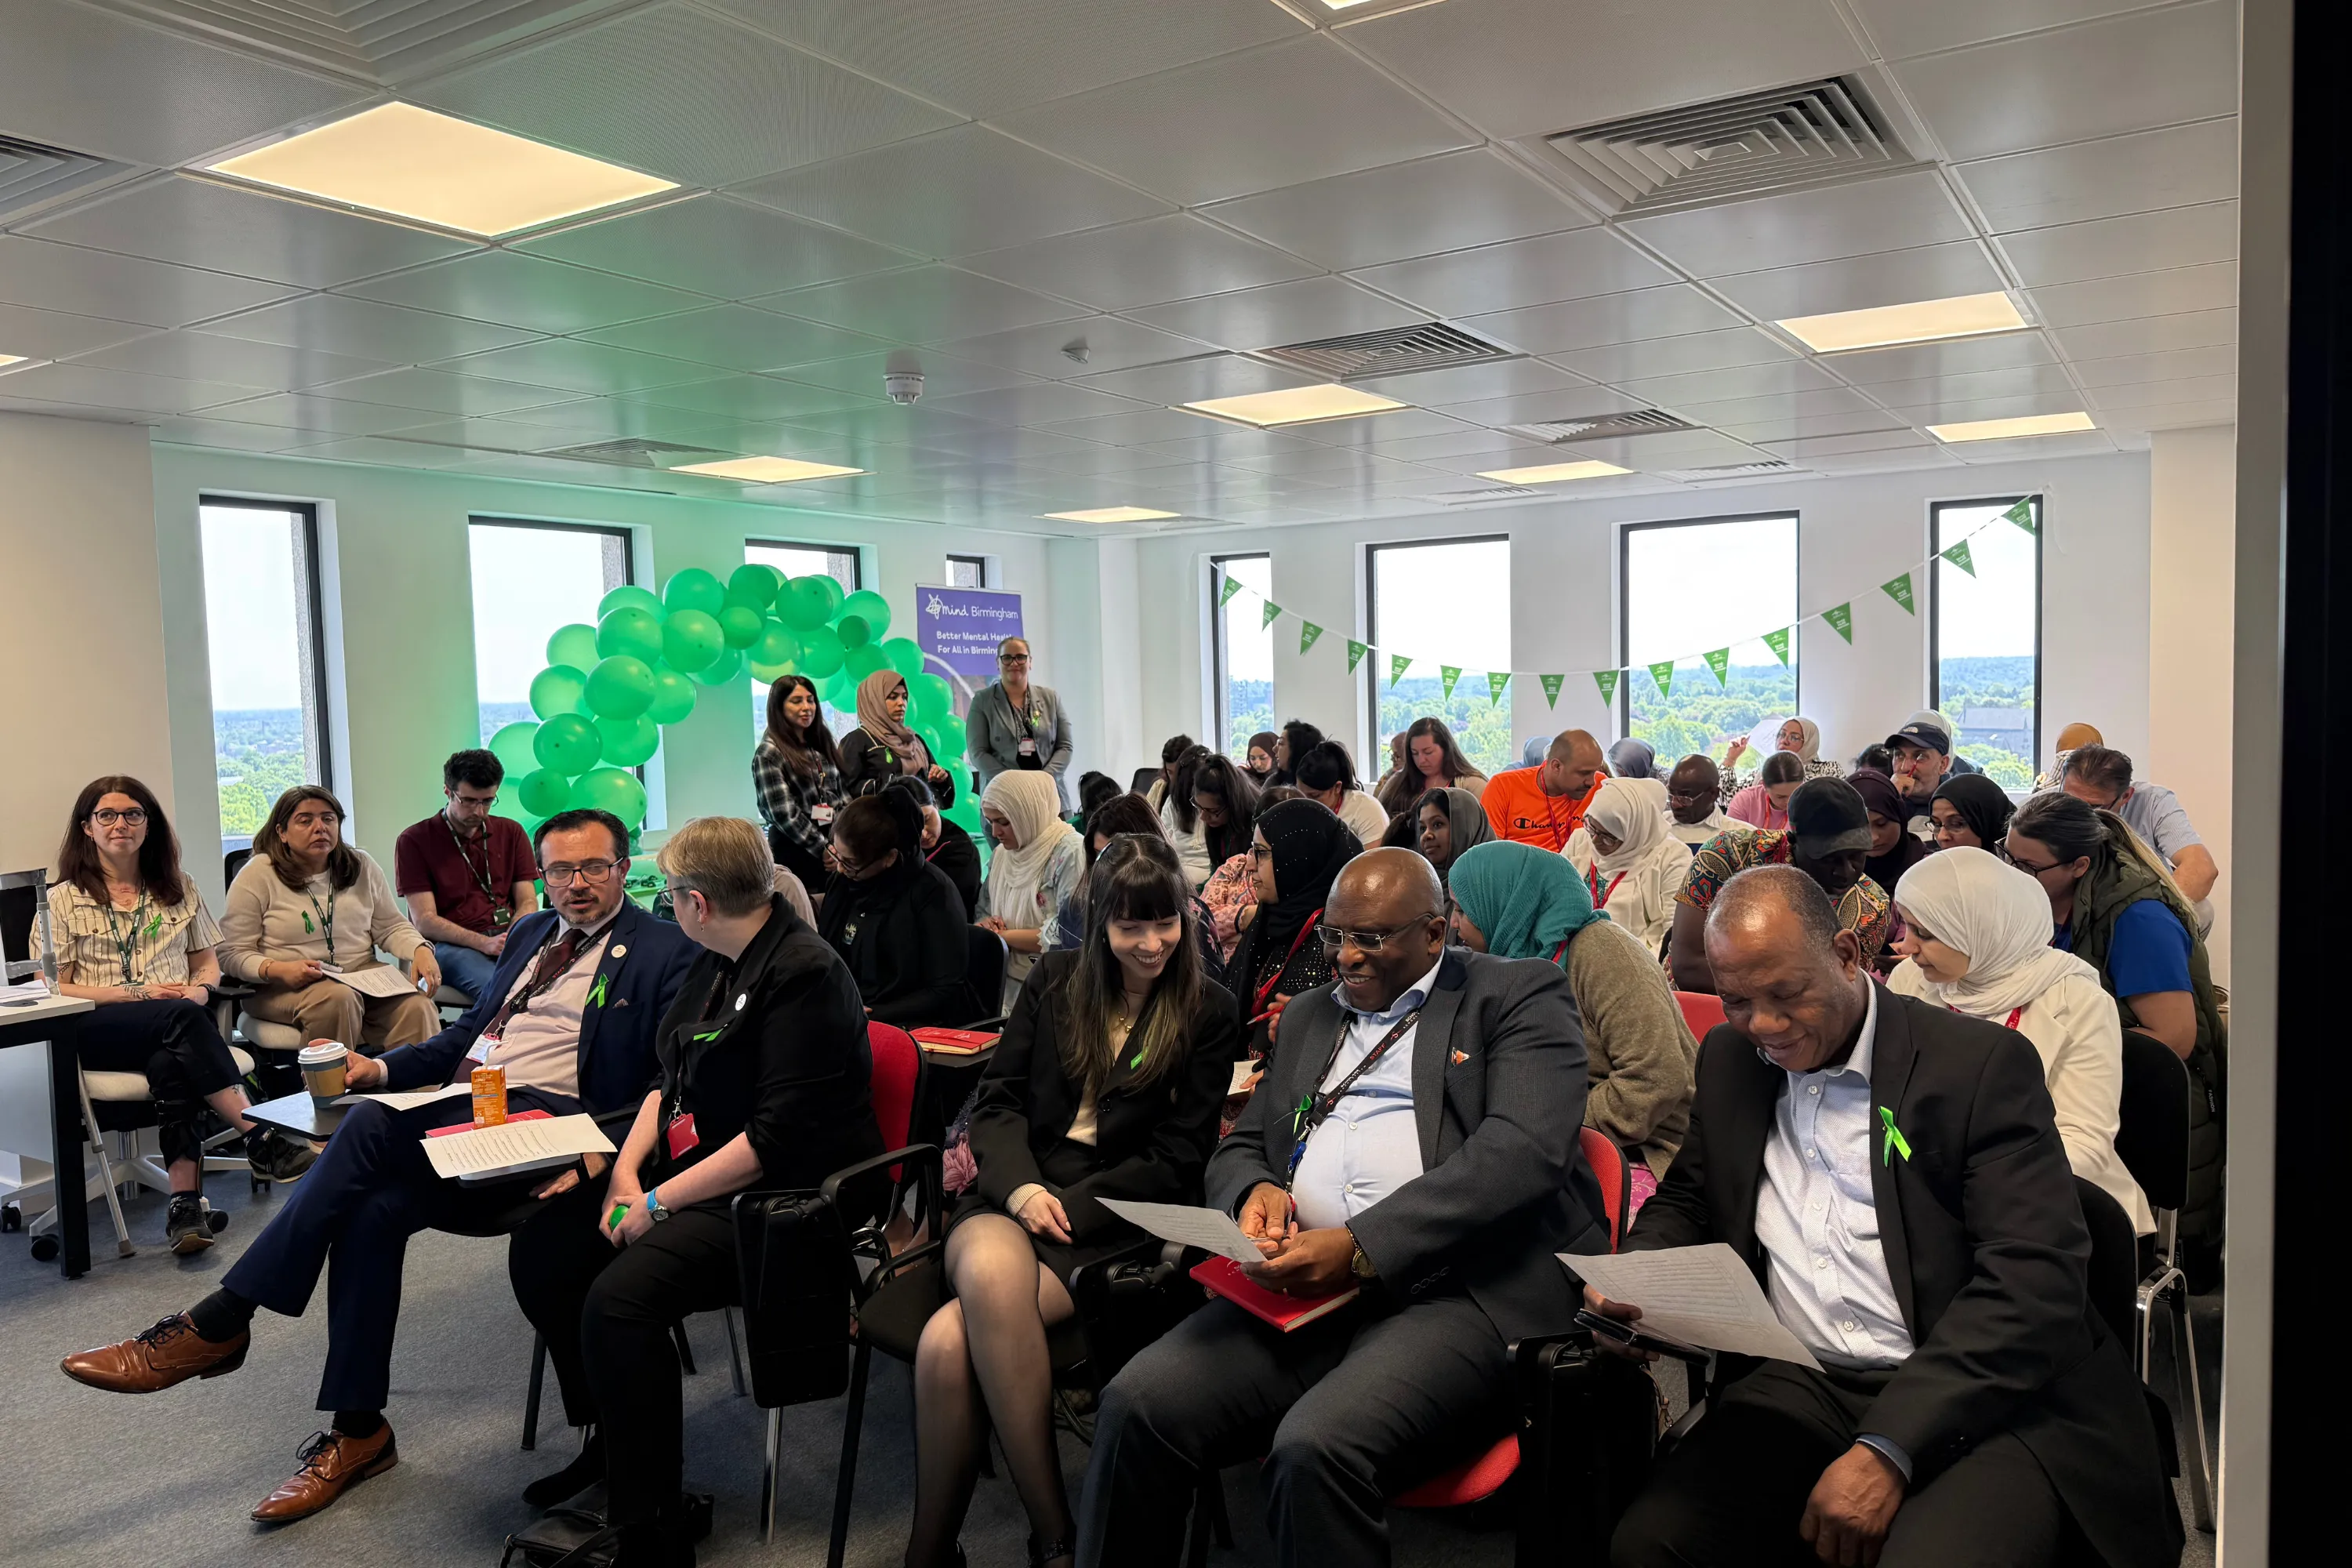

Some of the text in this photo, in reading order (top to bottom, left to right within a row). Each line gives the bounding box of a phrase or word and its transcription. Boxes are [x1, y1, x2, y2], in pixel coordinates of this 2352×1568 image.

[942, 604, 1018, 621] mind Birmingham
[936, 630, 961, 640] Better
[962, 632, 989, 641] Mental
[952, 645, 962, 654] All
[1369, 1043, 1387, 1060] STAFF
